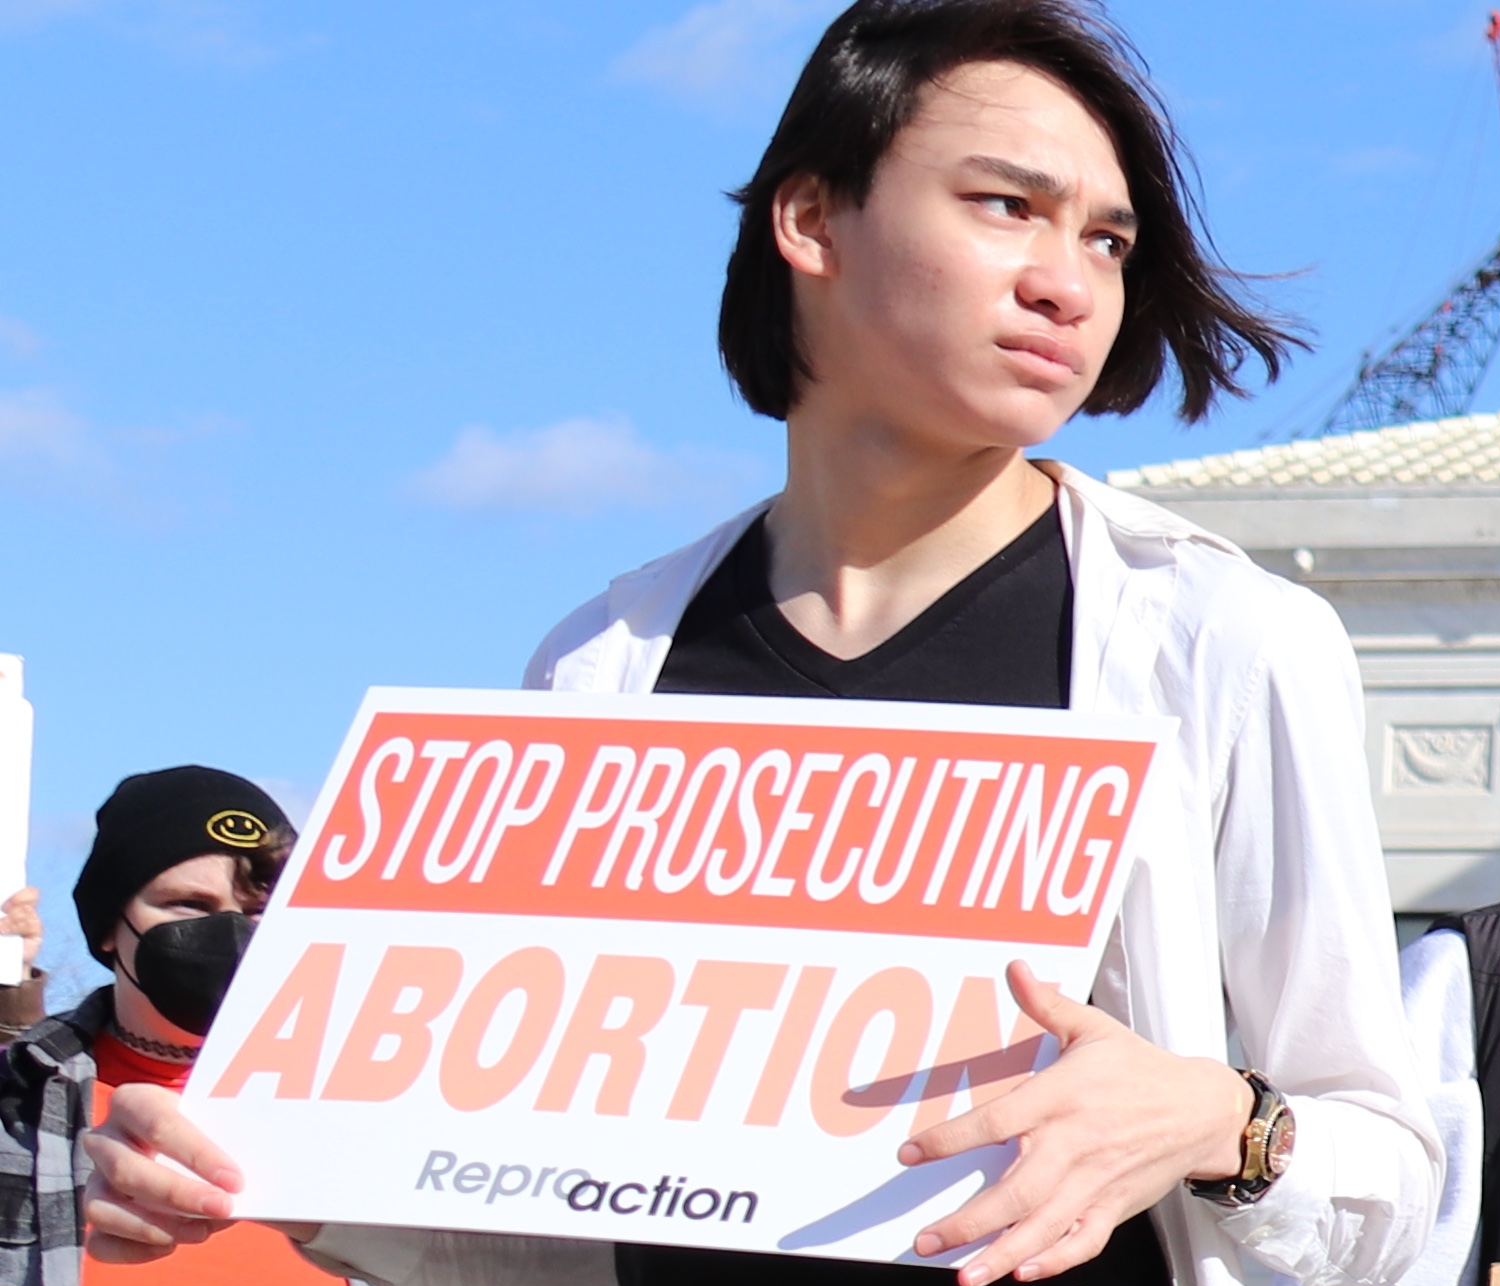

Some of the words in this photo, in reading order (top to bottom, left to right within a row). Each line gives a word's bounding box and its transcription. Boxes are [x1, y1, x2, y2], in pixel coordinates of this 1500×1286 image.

[321, 736, 566, 885] STOP
[541, 744, 1130, 917] PROSECUTING
[207, 942, 1061, 1139] ABORTION
